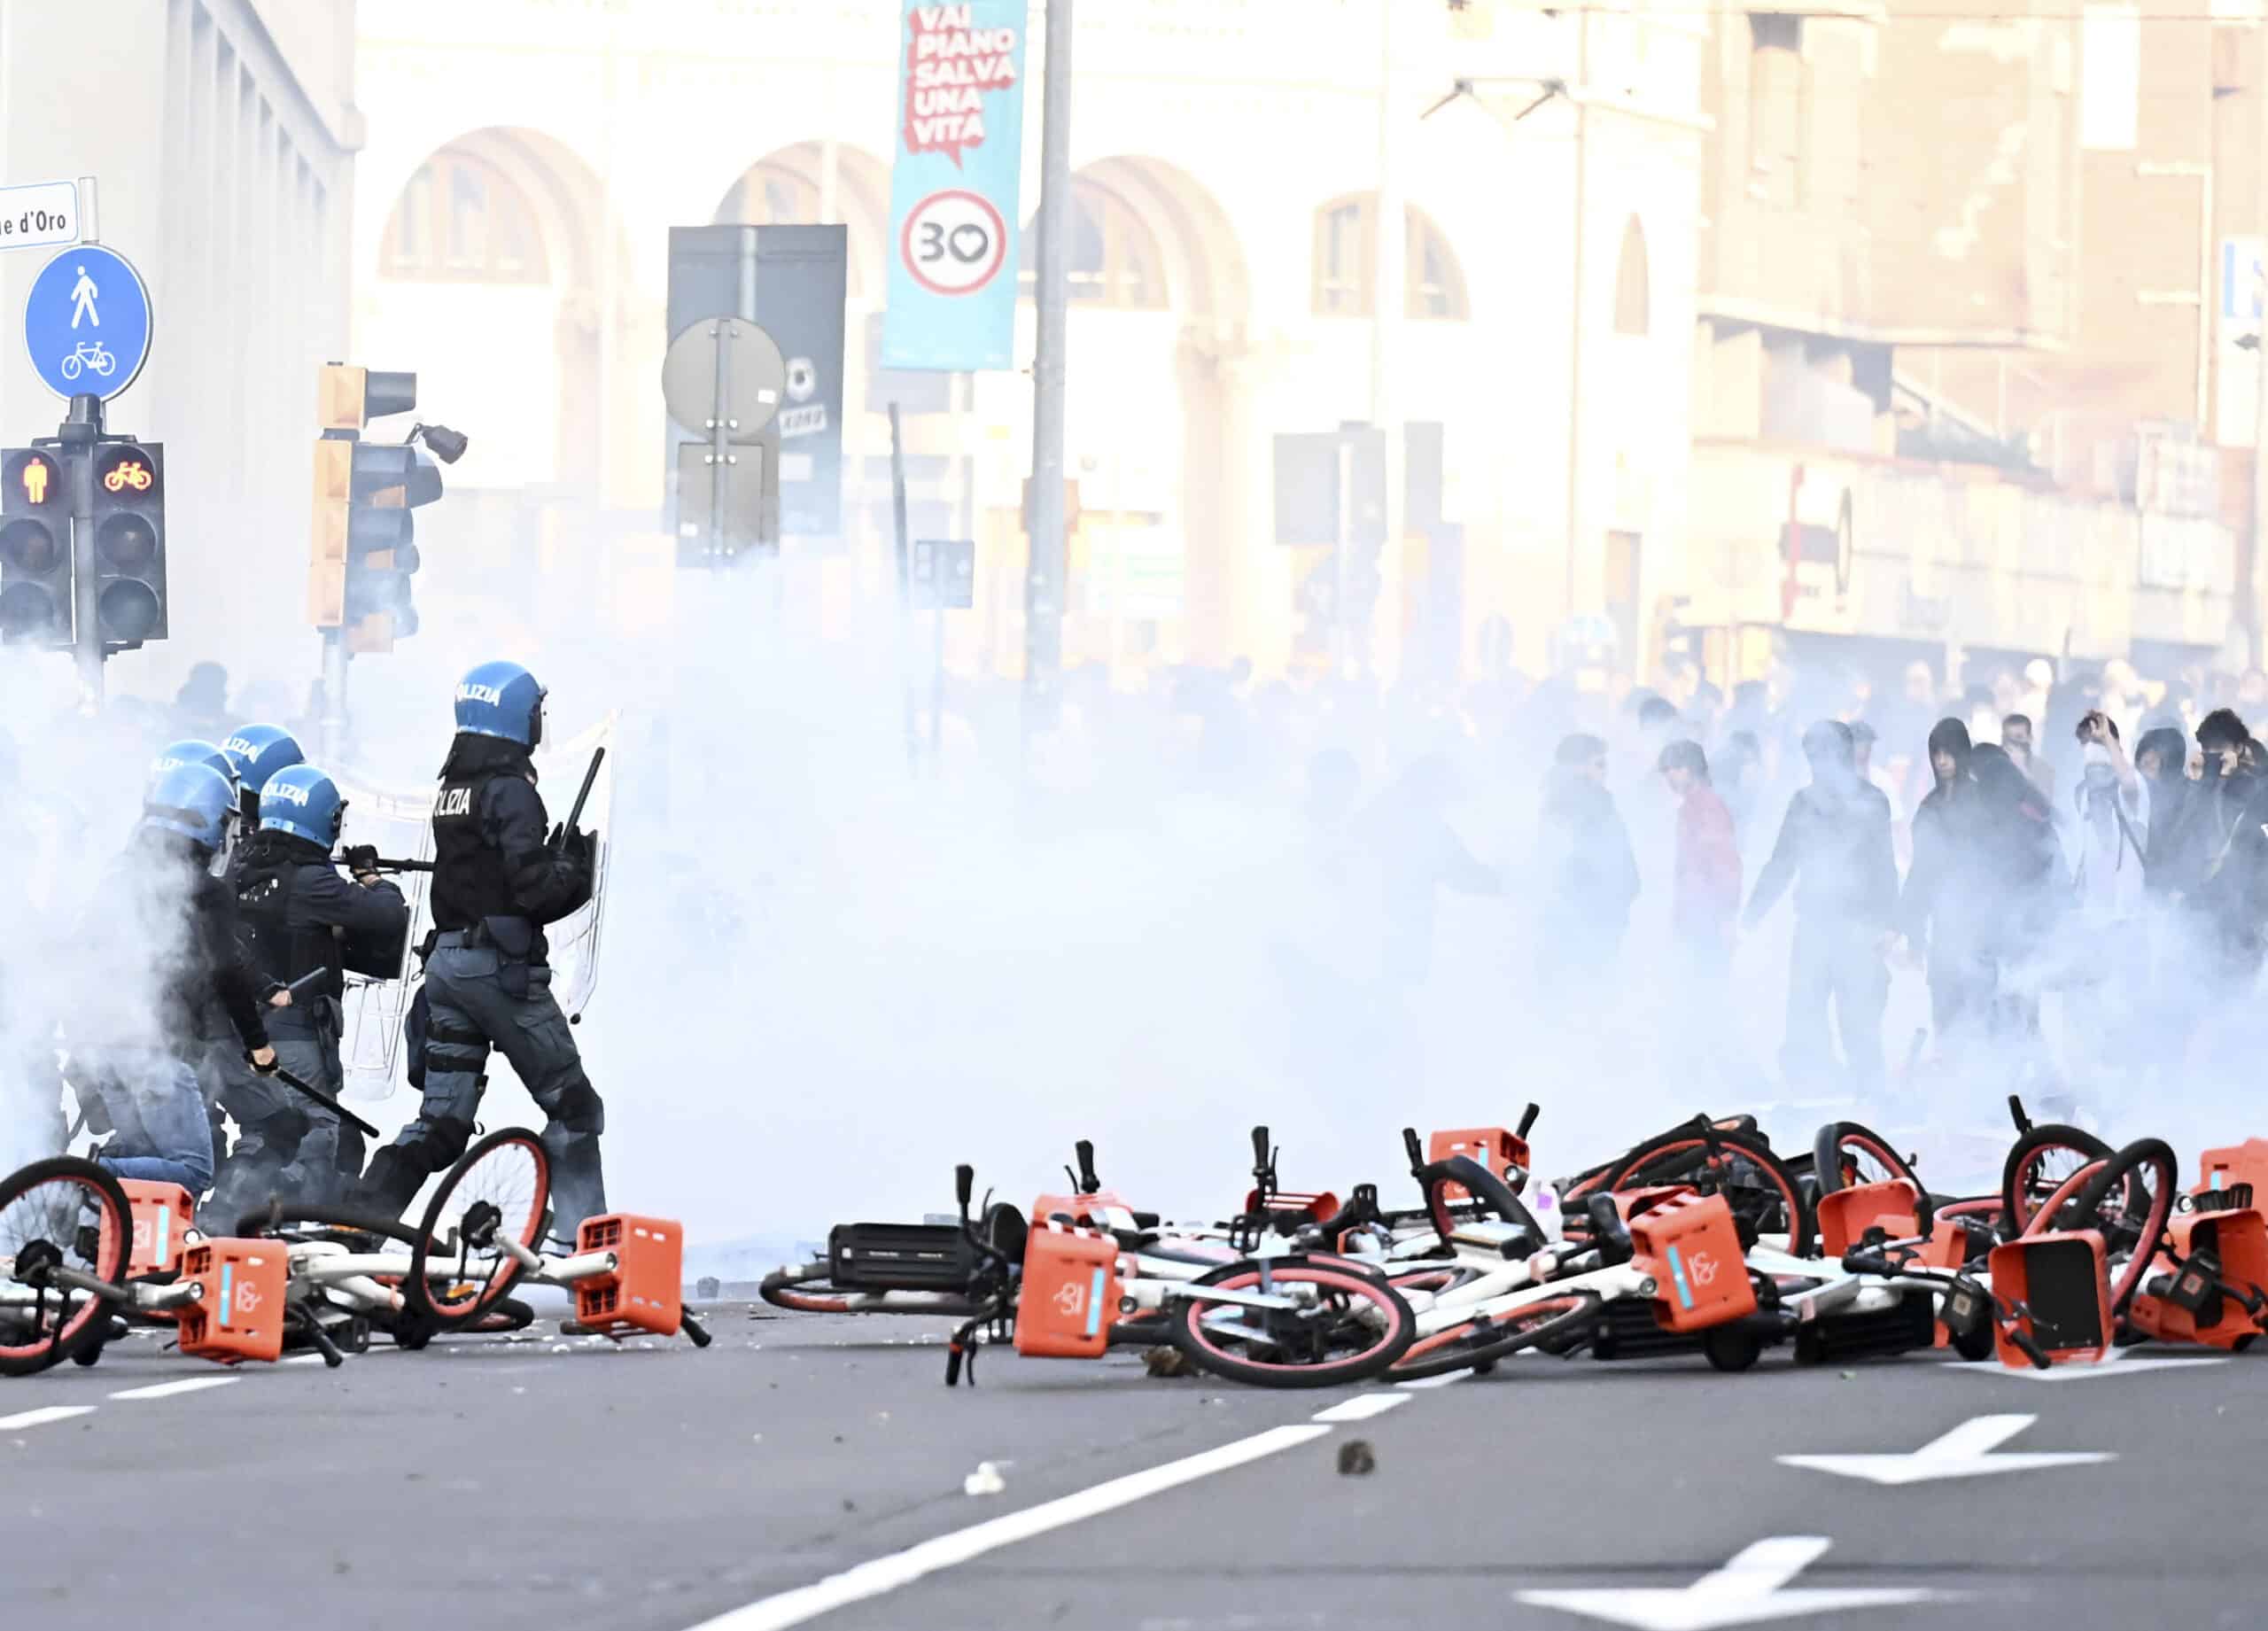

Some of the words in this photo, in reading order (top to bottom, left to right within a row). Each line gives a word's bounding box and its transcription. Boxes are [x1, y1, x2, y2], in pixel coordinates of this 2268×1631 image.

[915, 4, 971, 32] VAI
[915, 28, 1017, 60] PIANO
[914, 55, 1017, 89] SALVA
[913, 88, 983, 117] UNA
[913, 113, 986, 144] VITA
[19, 210, 66, 233] d'Oro
[920, 221, 989, 263] 30
